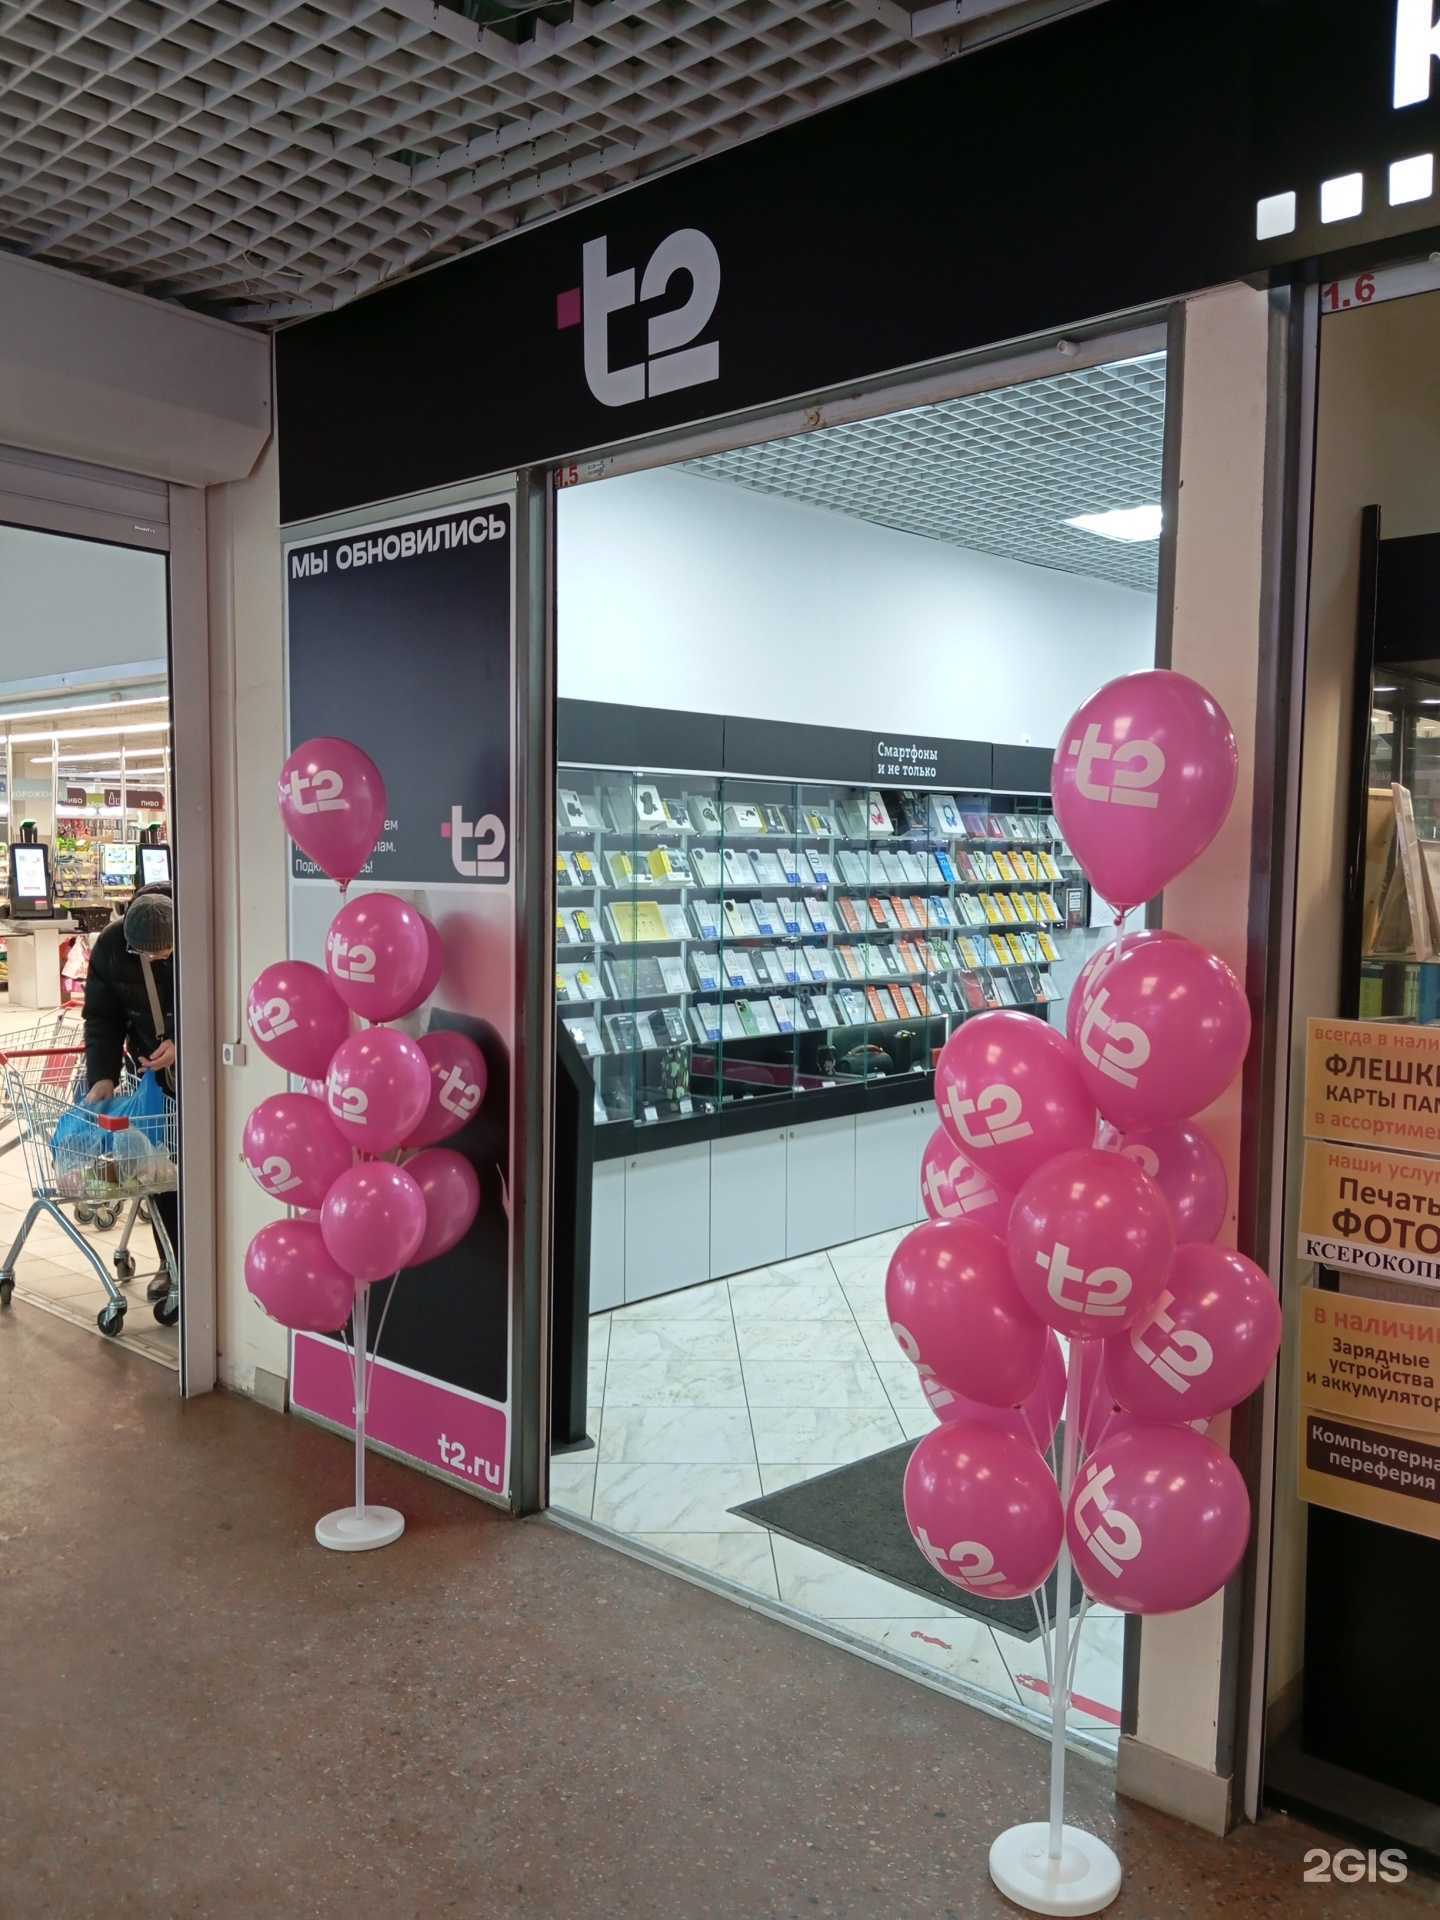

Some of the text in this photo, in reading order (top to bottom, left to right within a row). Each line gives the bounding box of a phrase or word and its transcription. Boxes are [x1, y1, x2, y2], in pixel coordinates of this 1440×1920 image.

[1324, 273, 1375, 310] 1.6
[556, 228, 721, 407] t2
[557, 463, 579, 488] 1.5
[292, 513, 506, 579] МЫ ОБНОВИЛИСЬ
[877, 742, 938, 763] Смартфоны
[877, 763, 937, 777] и не только
[1069, 723, 1166, 809] t2
[280, 769, 350, 814] t2
[441, 805, 506, 878] t2
[328, 933, 376, 983] t2
[249, 997, 299, 1042] t2
[1080, 987, 1151, 1089] t2
[1315, 1028, 1372, 1046] всегда
[1378, 1033, 1387, 1045] в
[327, 1062, 369, 1125] t2
[438, 1065, 481, 1121] t2
[1326, 1085, 1395, 1109] КАРТЫ
[943, 1083, 1034, 1149] t2
[1315, 1112, 1440, 1140] в ассортиме
[1328, 1154, 1382, 1175] наши
[1339, 1176, 1440, 1217] Печать
[1332, 1207, 1440, 1255] ФОТО
[1036, 1242, 1132, 1316] t2
[1131, 1289, 1214, 1394] t2
[1334, 1311, 1440, 1344] наличи
[1329, 1358, 1434, 1388] устройства
[1332, 1337, 1430, 1369] Зарядные
[1307, 1372, 1316, 1384] и
[437, 1433, 500, 1486] t2.ru
[1329, 1452, 1436, 1490] переферия
[1074, 1463, 1142, 1579] t2
